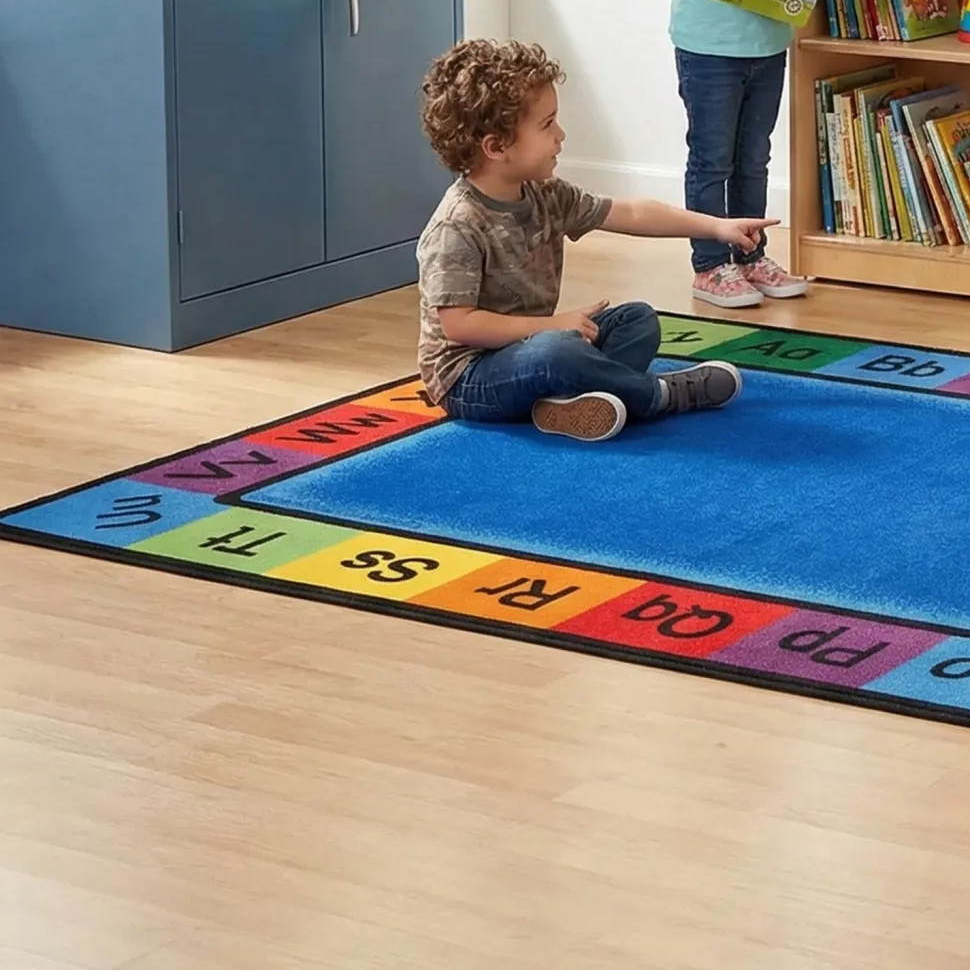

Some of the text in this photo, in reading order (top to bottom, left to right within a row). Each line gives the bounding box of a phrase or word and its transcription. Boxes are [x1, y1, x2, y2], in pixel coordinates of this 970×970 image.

[738, 340, 824, 361] Aa
[858, 354, 946, 379] Bb
[274, 411, 398, 444] Ww
[163, 450, 279, 480] Vv
[95, 494, 162, 530] Uu
[198, 525, 287, 557] Tt
[340, 550, 440, 583] Ss
[474, 577, 580, 611] Rr
[621, 594, 735, 639] Qq
[777, 626, 892, 669] Pp
